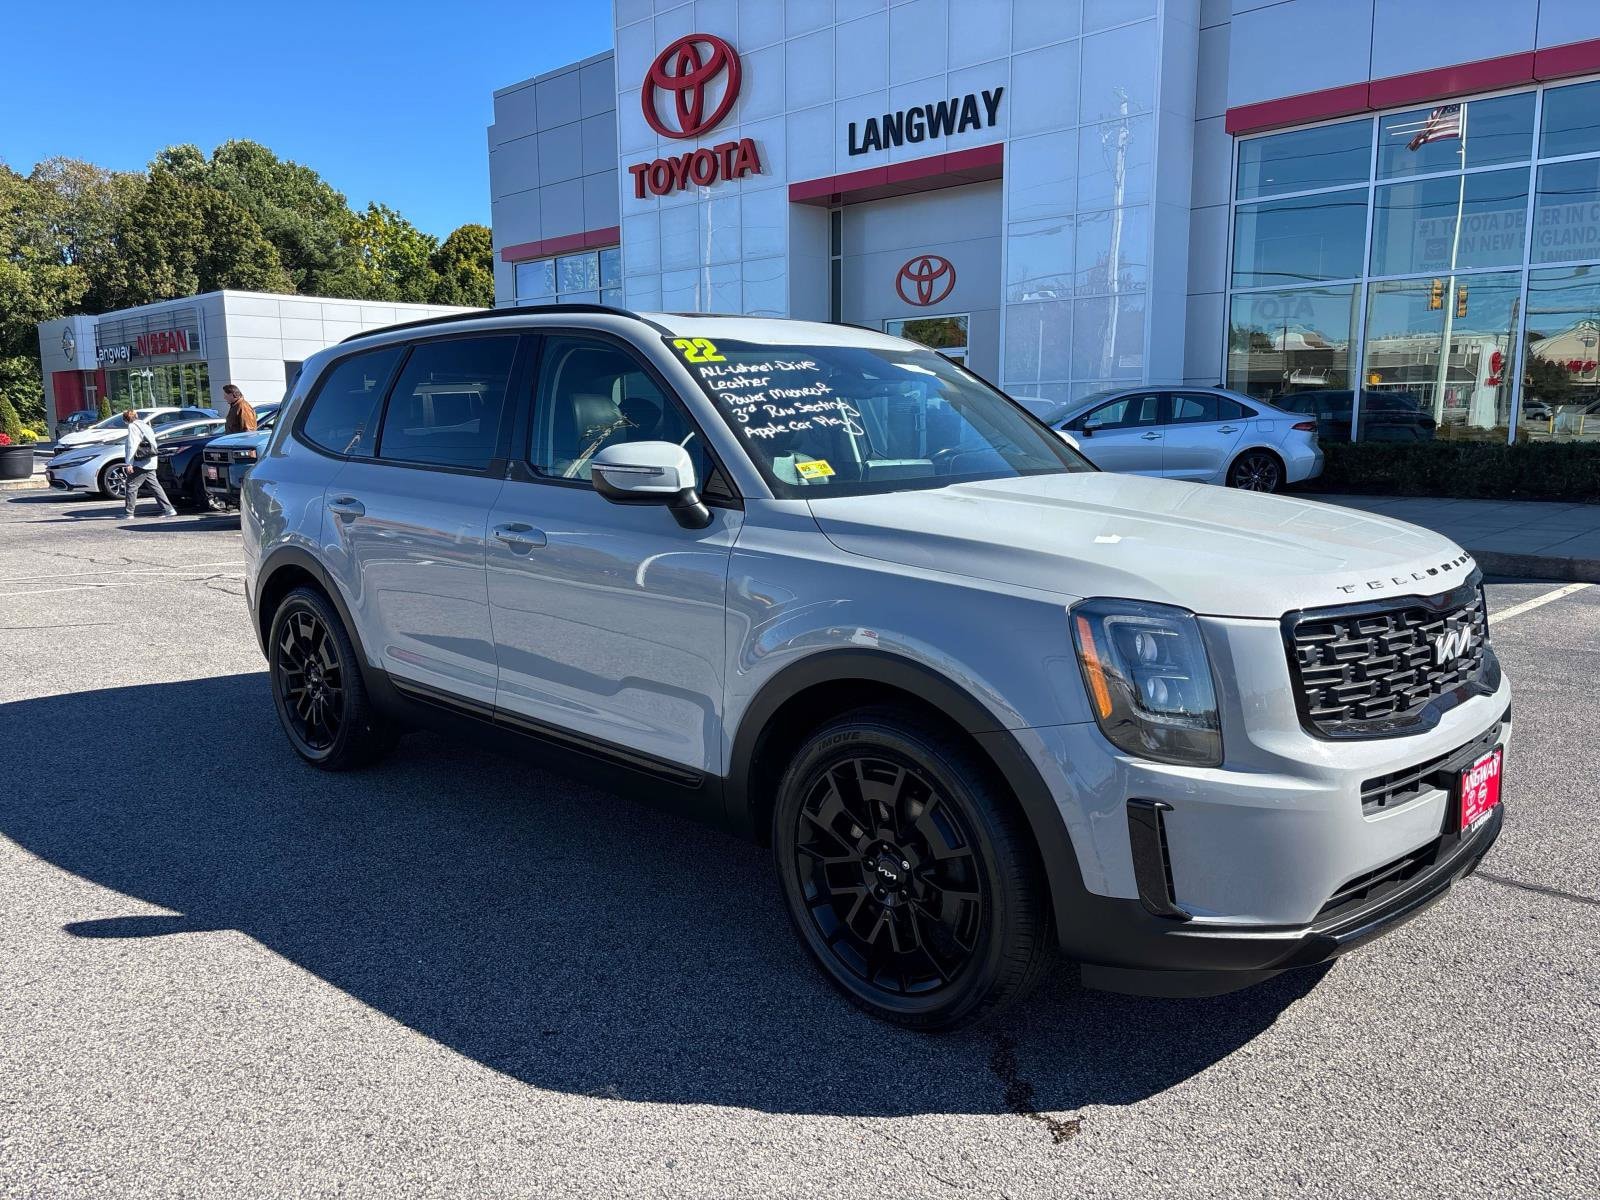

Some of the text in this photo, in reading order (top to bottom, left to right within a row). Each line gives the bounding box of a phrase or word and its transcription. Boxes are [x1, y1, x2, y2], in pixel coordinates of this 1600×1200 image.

[848, 87, 1003, 156] LANGWAY
[629, 138, 762, 199] TOYOTA
[1443, 213, 1498, 234] TOYOTA
[1566, 203, 1584, 221] IN
[1480, 232, 1514, 252] NEW
[96, 329, 190, 362] Langway NISSAN
[673, 338, 727, 362] 22
[708, 376, 770, 390] Leather
[720, 392, 767, 406] Power
[732, 401, 860, 423] 3rd Row Seating
[744, 424, 790, 439] Apple
[812, 416, 864, 436] Play
[1336, 551, 1472, 594] TELLURIDE
